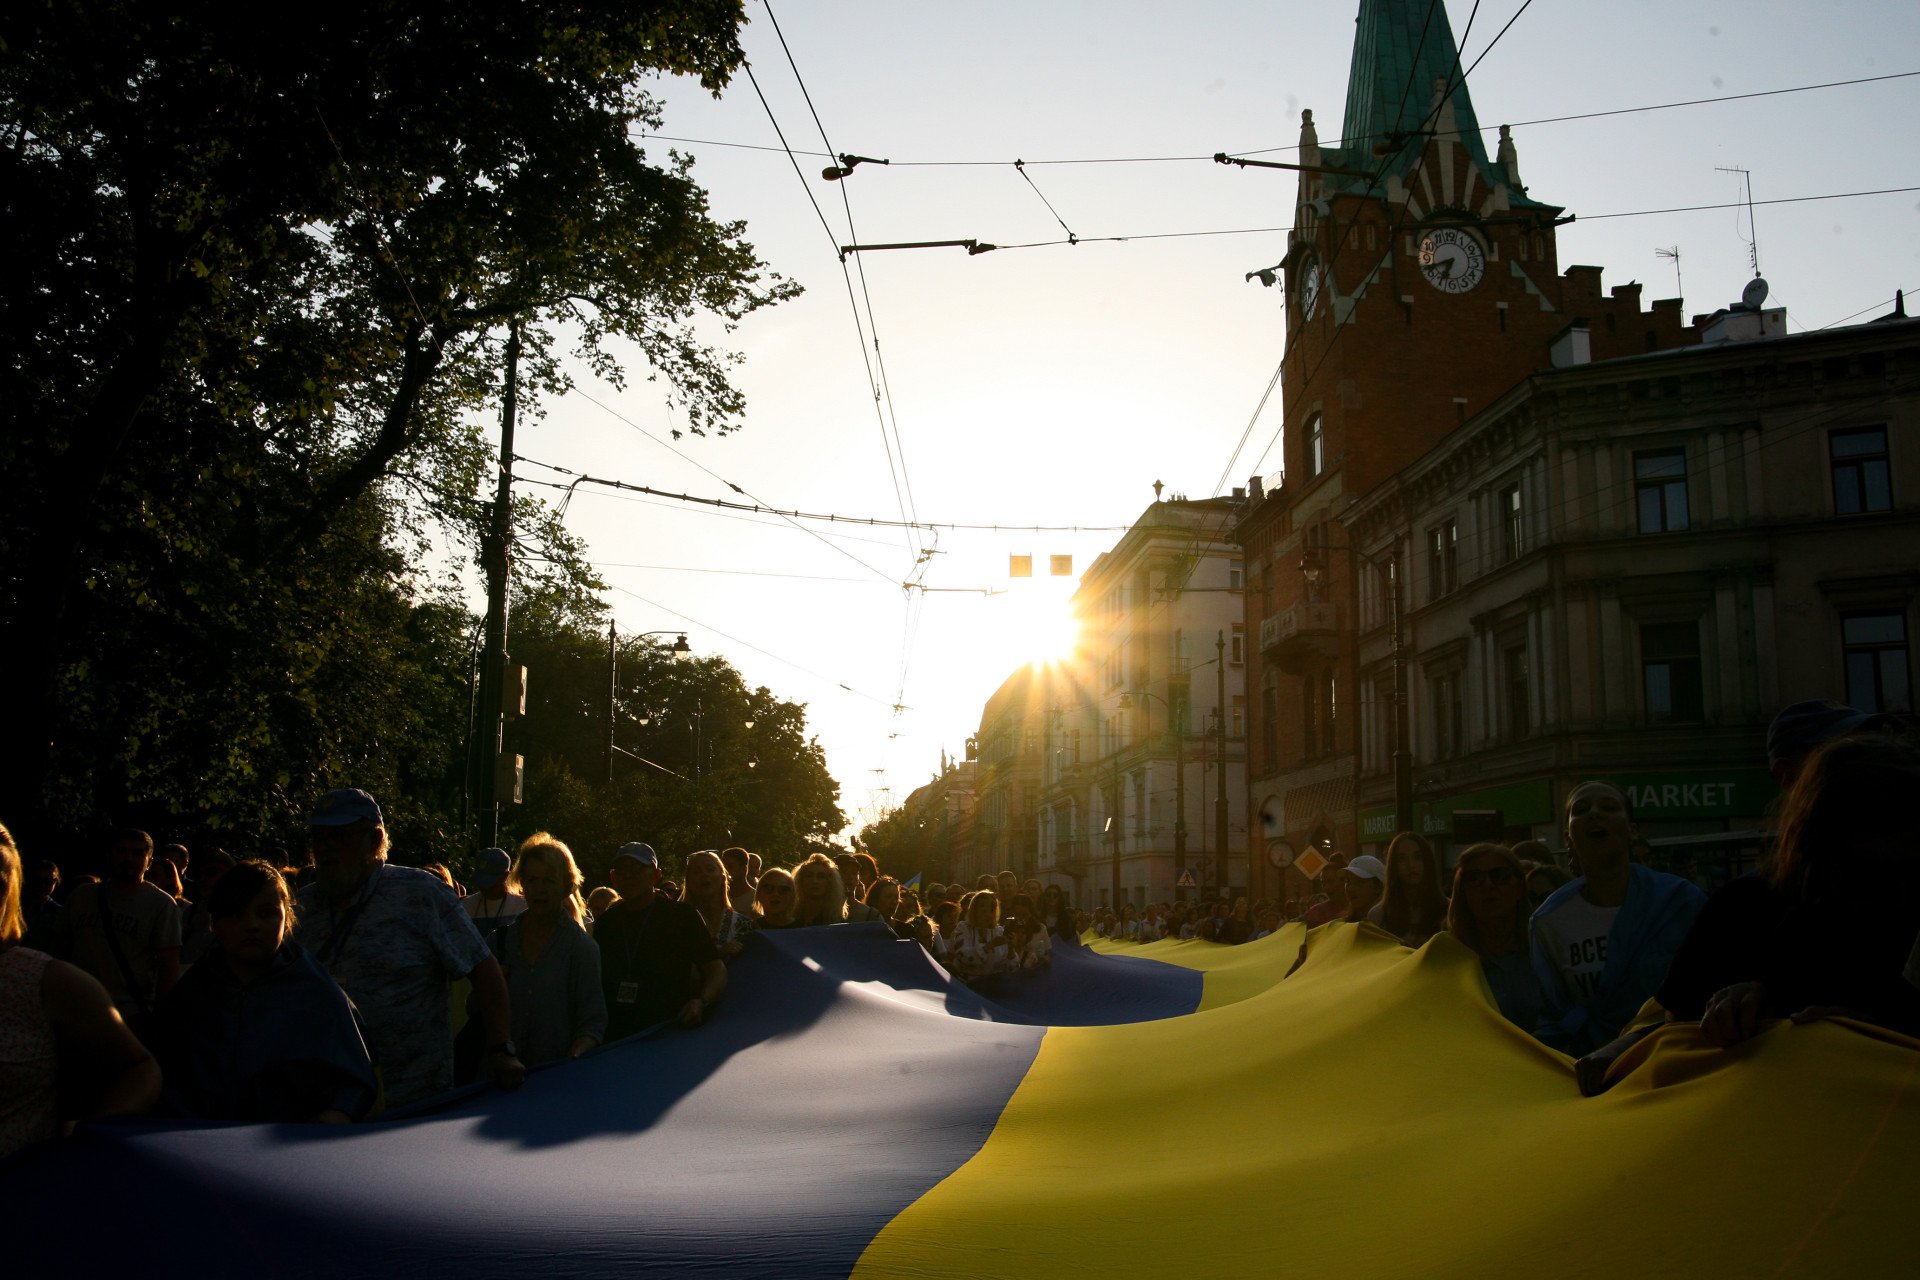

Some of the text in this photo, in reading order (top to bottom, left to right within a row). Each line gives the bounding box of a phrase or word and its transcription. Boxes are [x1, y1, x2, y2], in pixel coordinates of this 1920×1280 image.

[1434, 233, 1442, 244] 11
[1445, 232, 1455, 242] 12
[1425, 242, 1434, 252] 10
[1468, 245, 1476, 255] 2
[1423, 254, 1431, 264] 9
[1472, 258, 1479, 268] 3
[1468, 270, 1476, 281] 4
[1448, 280, 1456, 290] 6
[1461, 277, 1468, 288] 5
[1364, 814, 1396, 835] MARKET
[1570, 936, 1608, 966] ВСЕ
